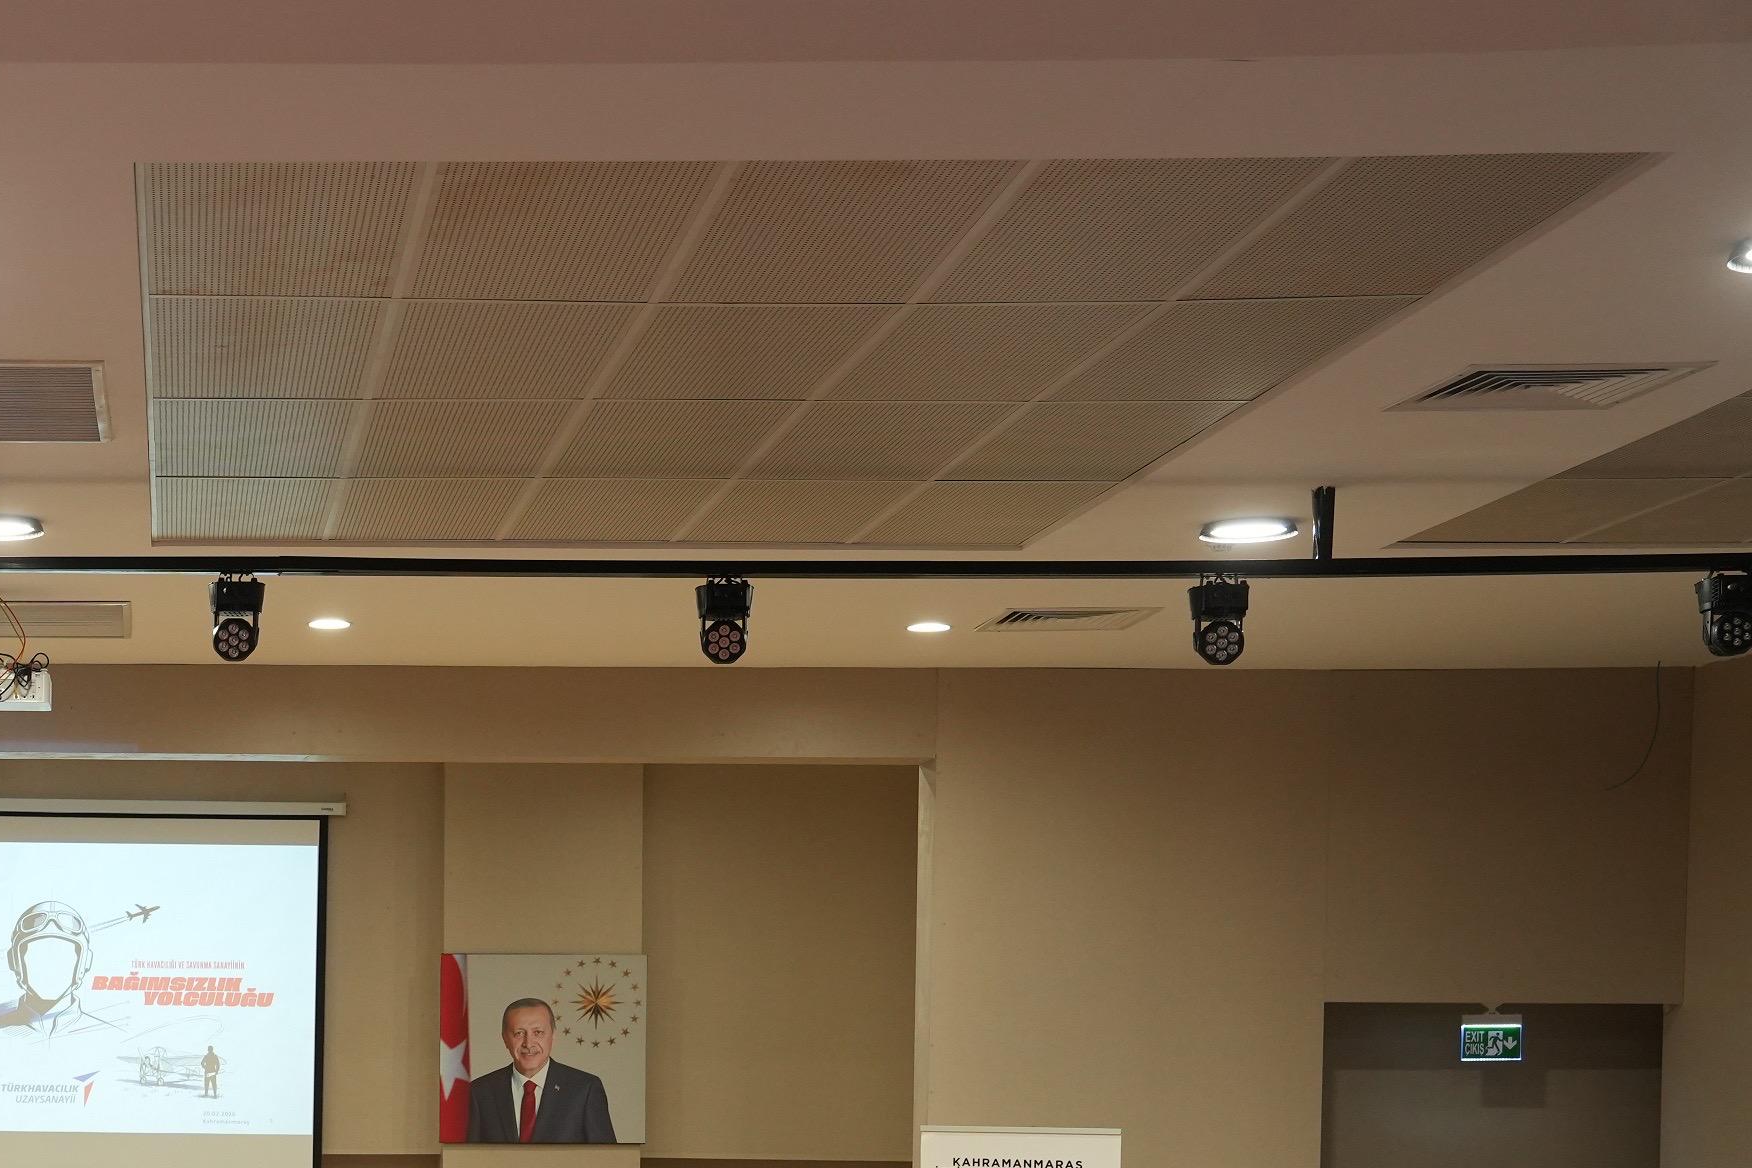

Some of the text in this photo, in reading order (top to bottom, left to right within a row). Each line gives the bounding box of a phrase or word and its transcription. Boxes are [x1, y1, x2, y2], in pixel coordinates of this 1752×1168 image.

[92, 971, 244, 992] BAĞIMSIZLIK
[144, 987, 275, 1007] YOLCULUĞU
[1465, 1031, 1485, 1043] EXIT
[1, 1082, 79, 1093] TÜRKHAVACILIK
[15, 1094, 76, 1104] UZAYSANAYİİ
